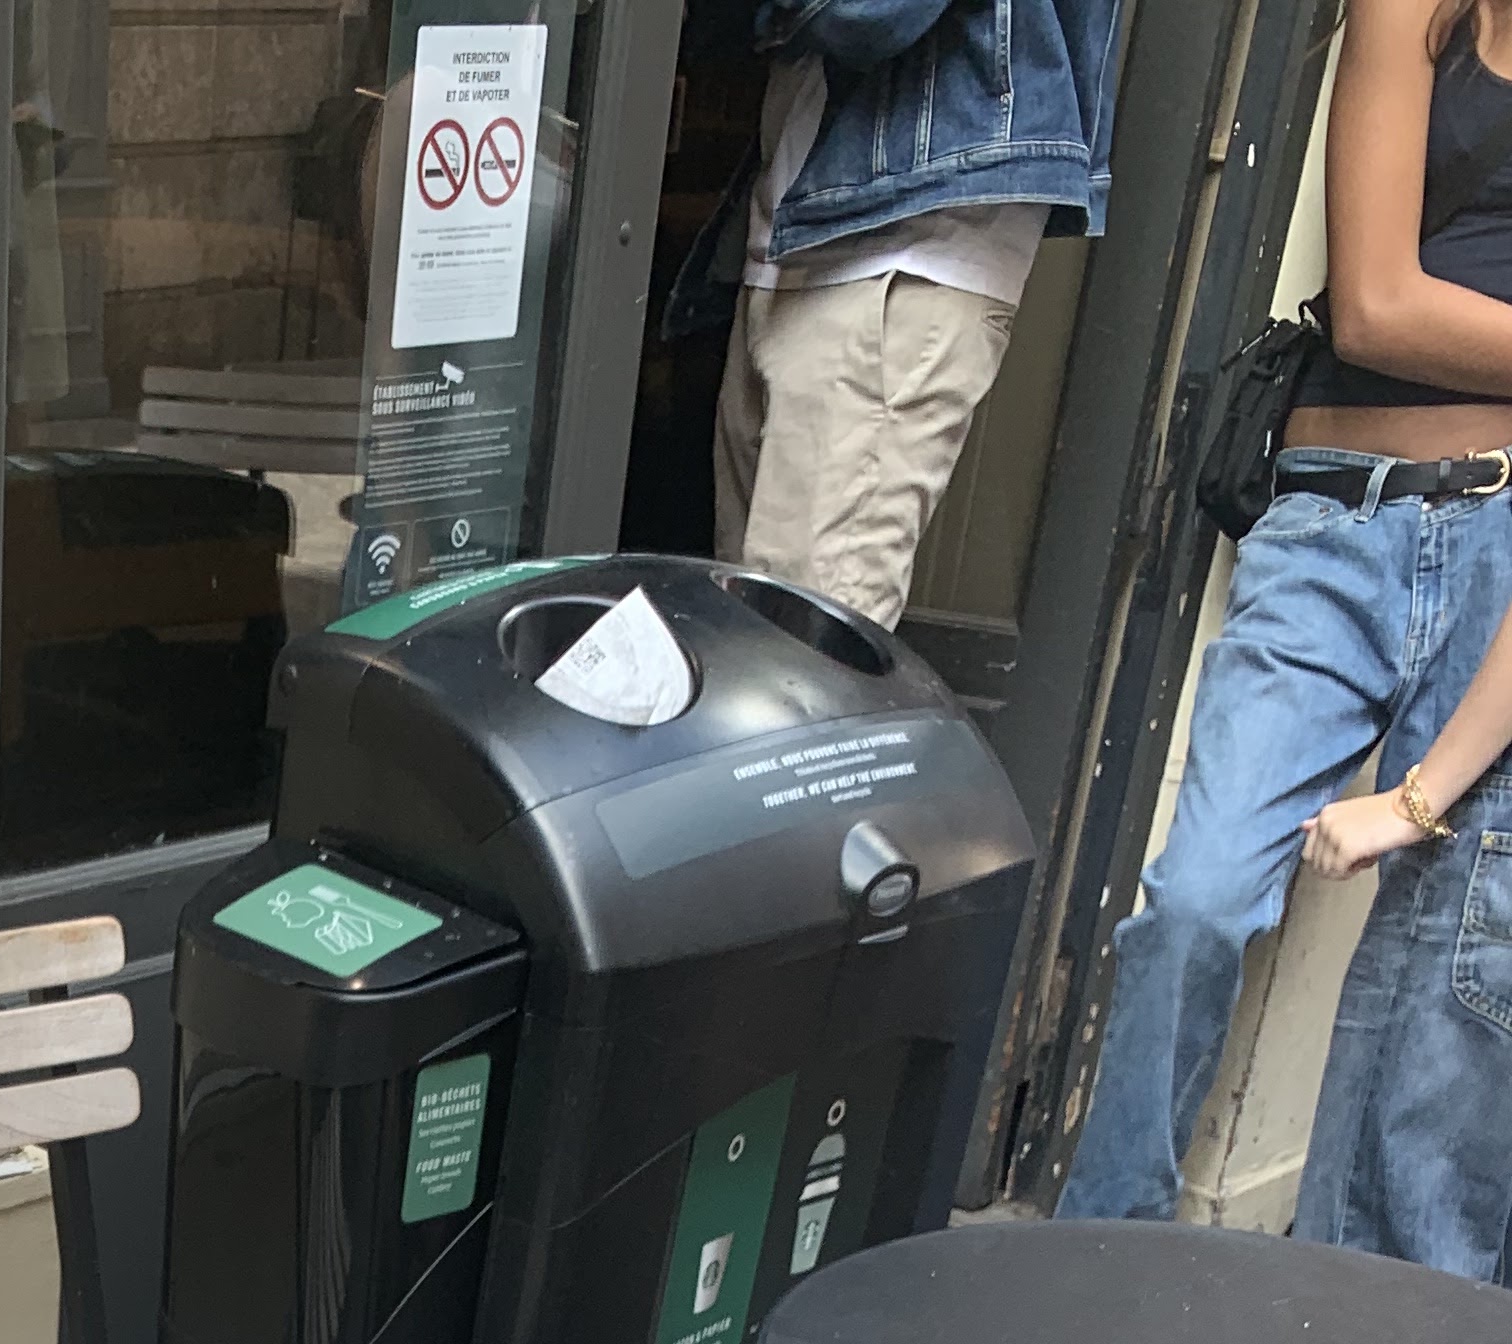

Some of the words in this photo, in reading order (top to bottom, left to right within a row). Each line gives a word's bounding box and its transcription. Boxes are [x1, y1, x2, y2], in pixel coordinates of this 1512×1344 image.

[452, 51, 511, 65] INTERDICTION
[458, 71, 470, 83] DE
[472, 70, 501, 83] FUMER
[446, 90, 456, 102] ET
[458, 90, 470, 102] DE
[472, 89, 510, 102] VAPOTER
